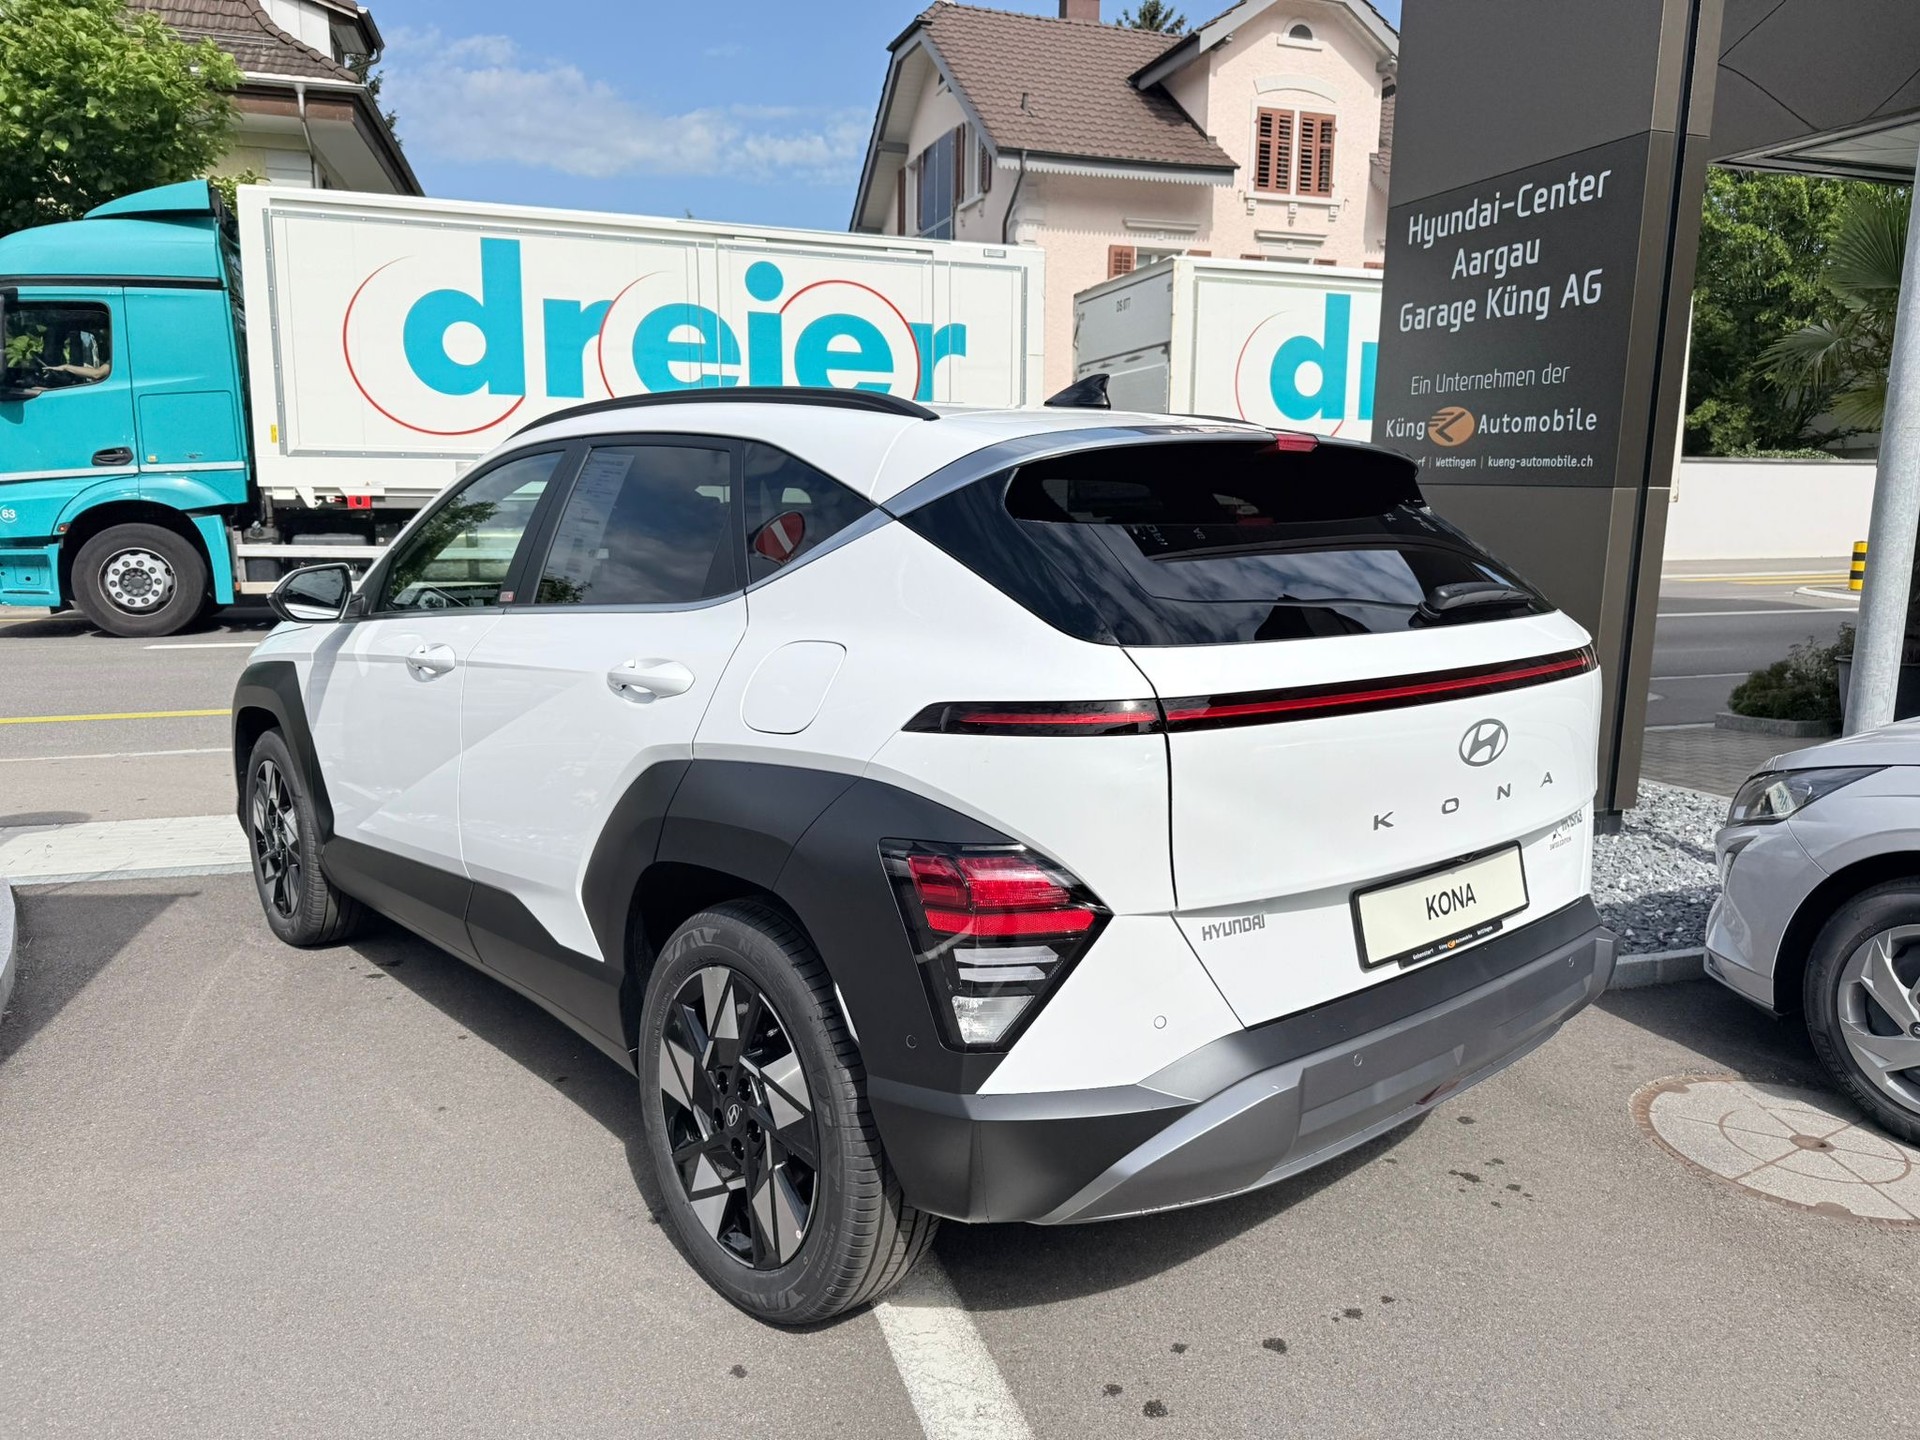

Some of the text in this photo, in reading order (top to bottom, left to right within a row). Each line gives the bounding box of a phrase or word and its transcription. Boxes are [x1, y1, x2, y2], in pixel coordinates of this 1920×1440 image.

[1408, 170, 1612, 249] Hyundai-Center
[1451, 238, 1541, 280] Aargau
[403, 237, 967, 402] dreier
[1400, 268, 1603, 333] Garage Küng AG
[1410, 363, 1571, 396] Ein Unternehmen der
[1385, 407, 1598, 441] Küng Automobile
[1435, 455, 1477, 469] Wettingen
[1487, 455, 1594, 470] kueng-automobile.ch
[1373, 771, 1553, 831] KONA
[1425, 882, 1477, 920] KONA
[1201, 913, 1266, 942] HYUNDAI
